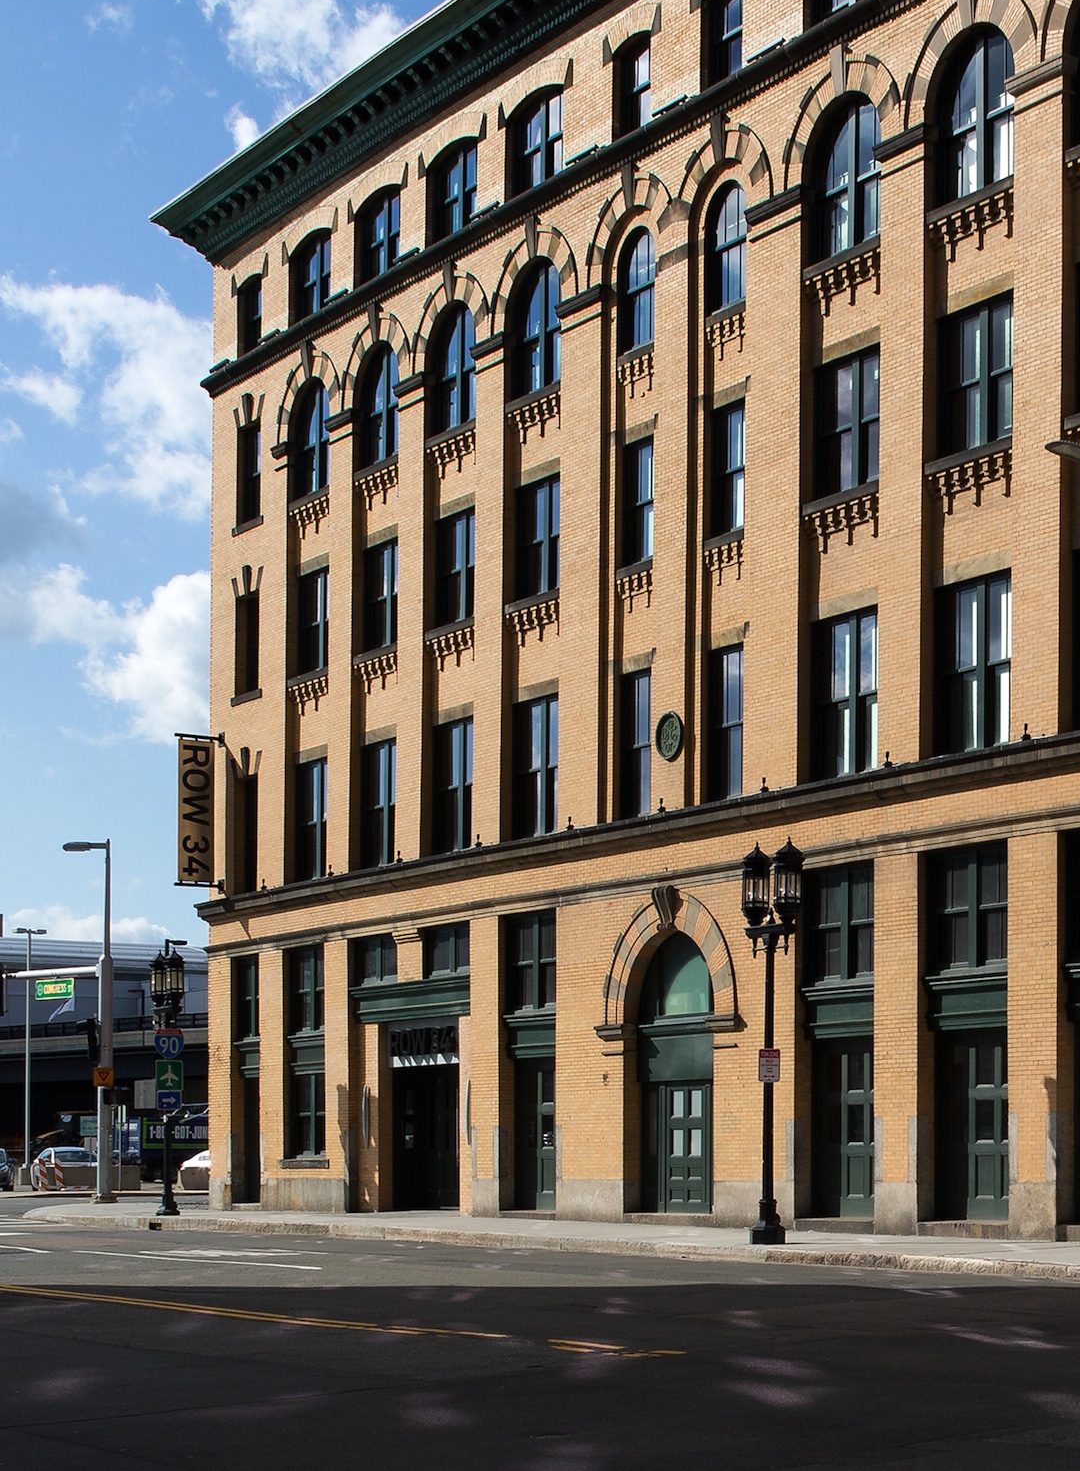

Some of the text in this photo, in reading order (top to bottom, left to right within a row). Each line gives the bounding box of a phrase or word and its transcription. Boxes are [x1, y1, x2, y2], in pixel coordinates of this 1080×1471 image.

[182, 744, 211, 877] ROW 34
[160, 1037, 179, 1054] 90
[389, 1026, 454, 1056] ROW 34
[149, 1125, 208, 1140] 1-80-GOT-JUN
